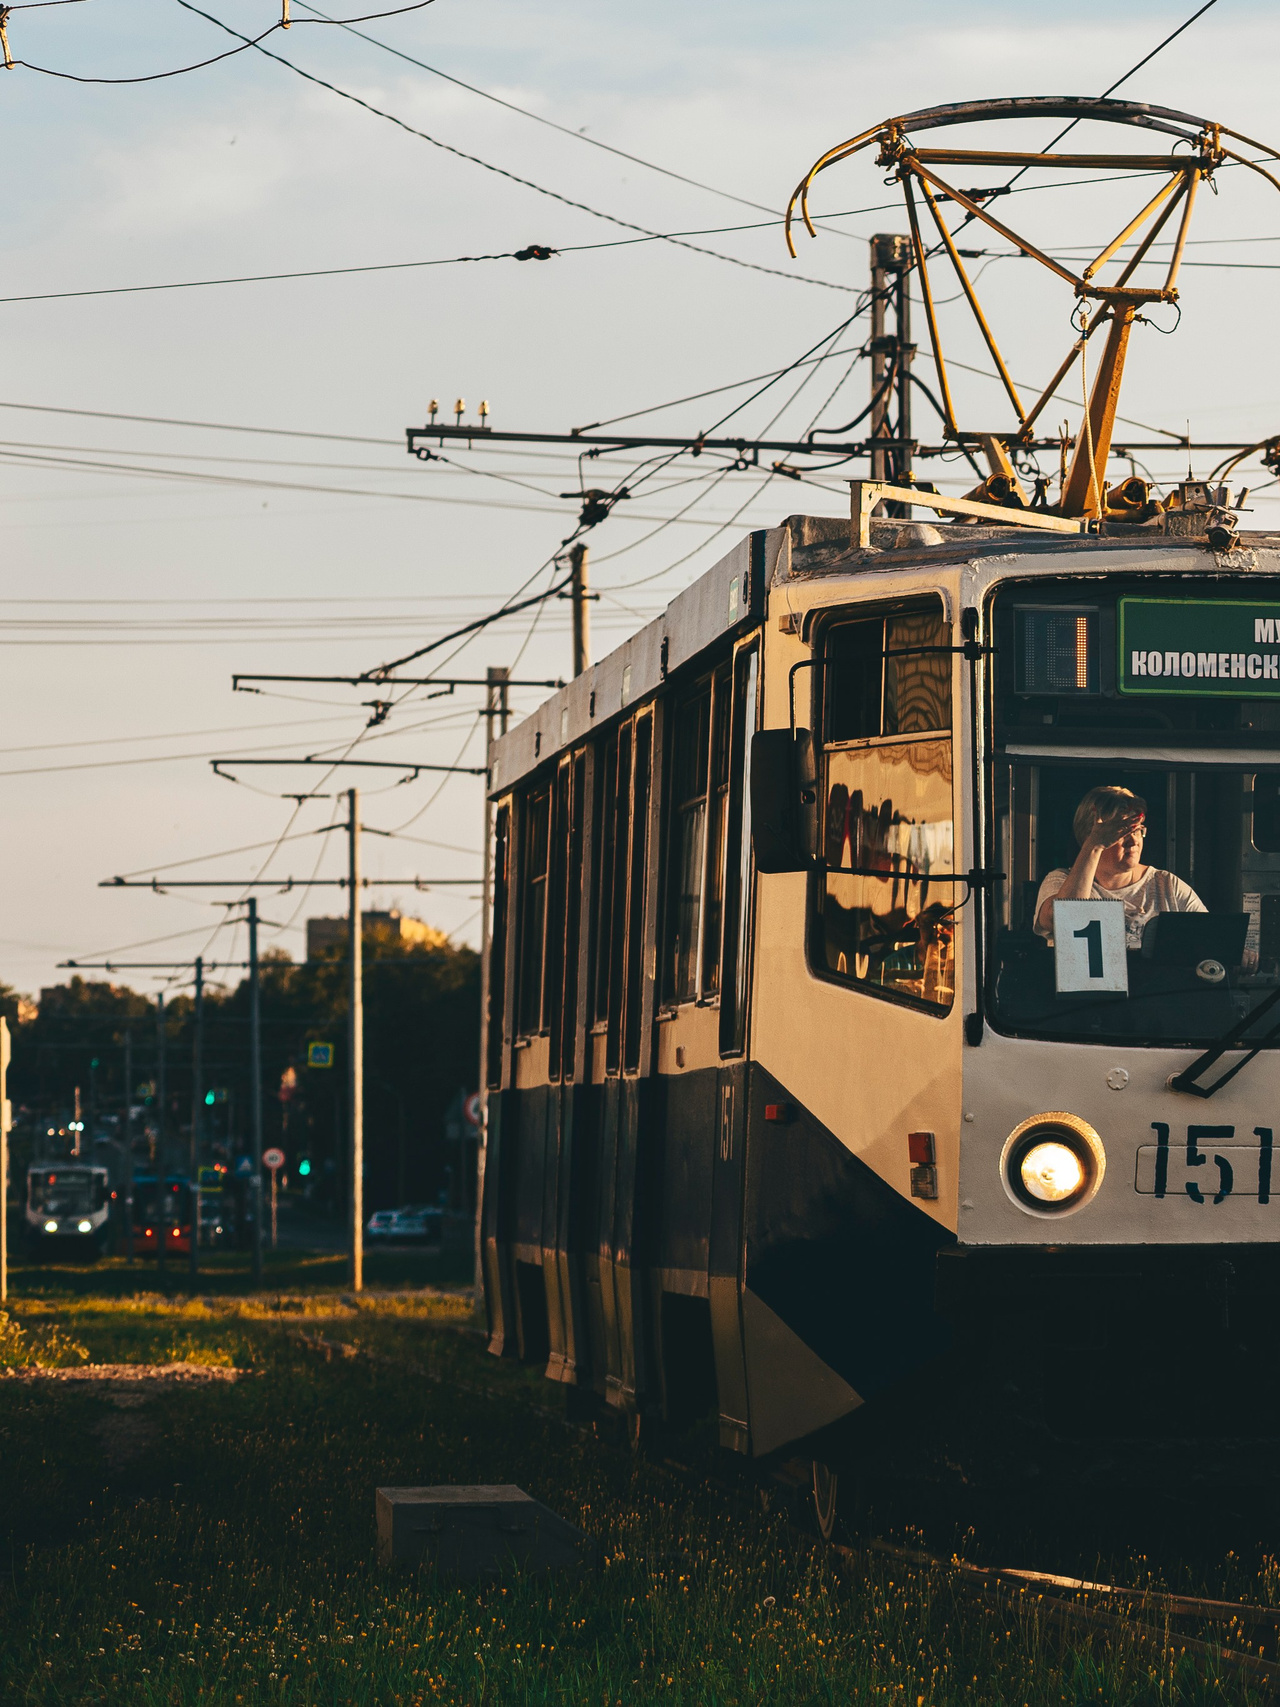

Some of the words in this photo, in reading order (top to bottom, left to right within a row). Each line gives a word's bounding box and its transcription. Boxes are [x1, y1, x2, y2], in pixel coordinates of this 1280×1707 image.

[1073, 920, 1104, 978] 1
[720, 1085, 735, 1161] 151
[1151, 1122, 1273, 1205] 151
